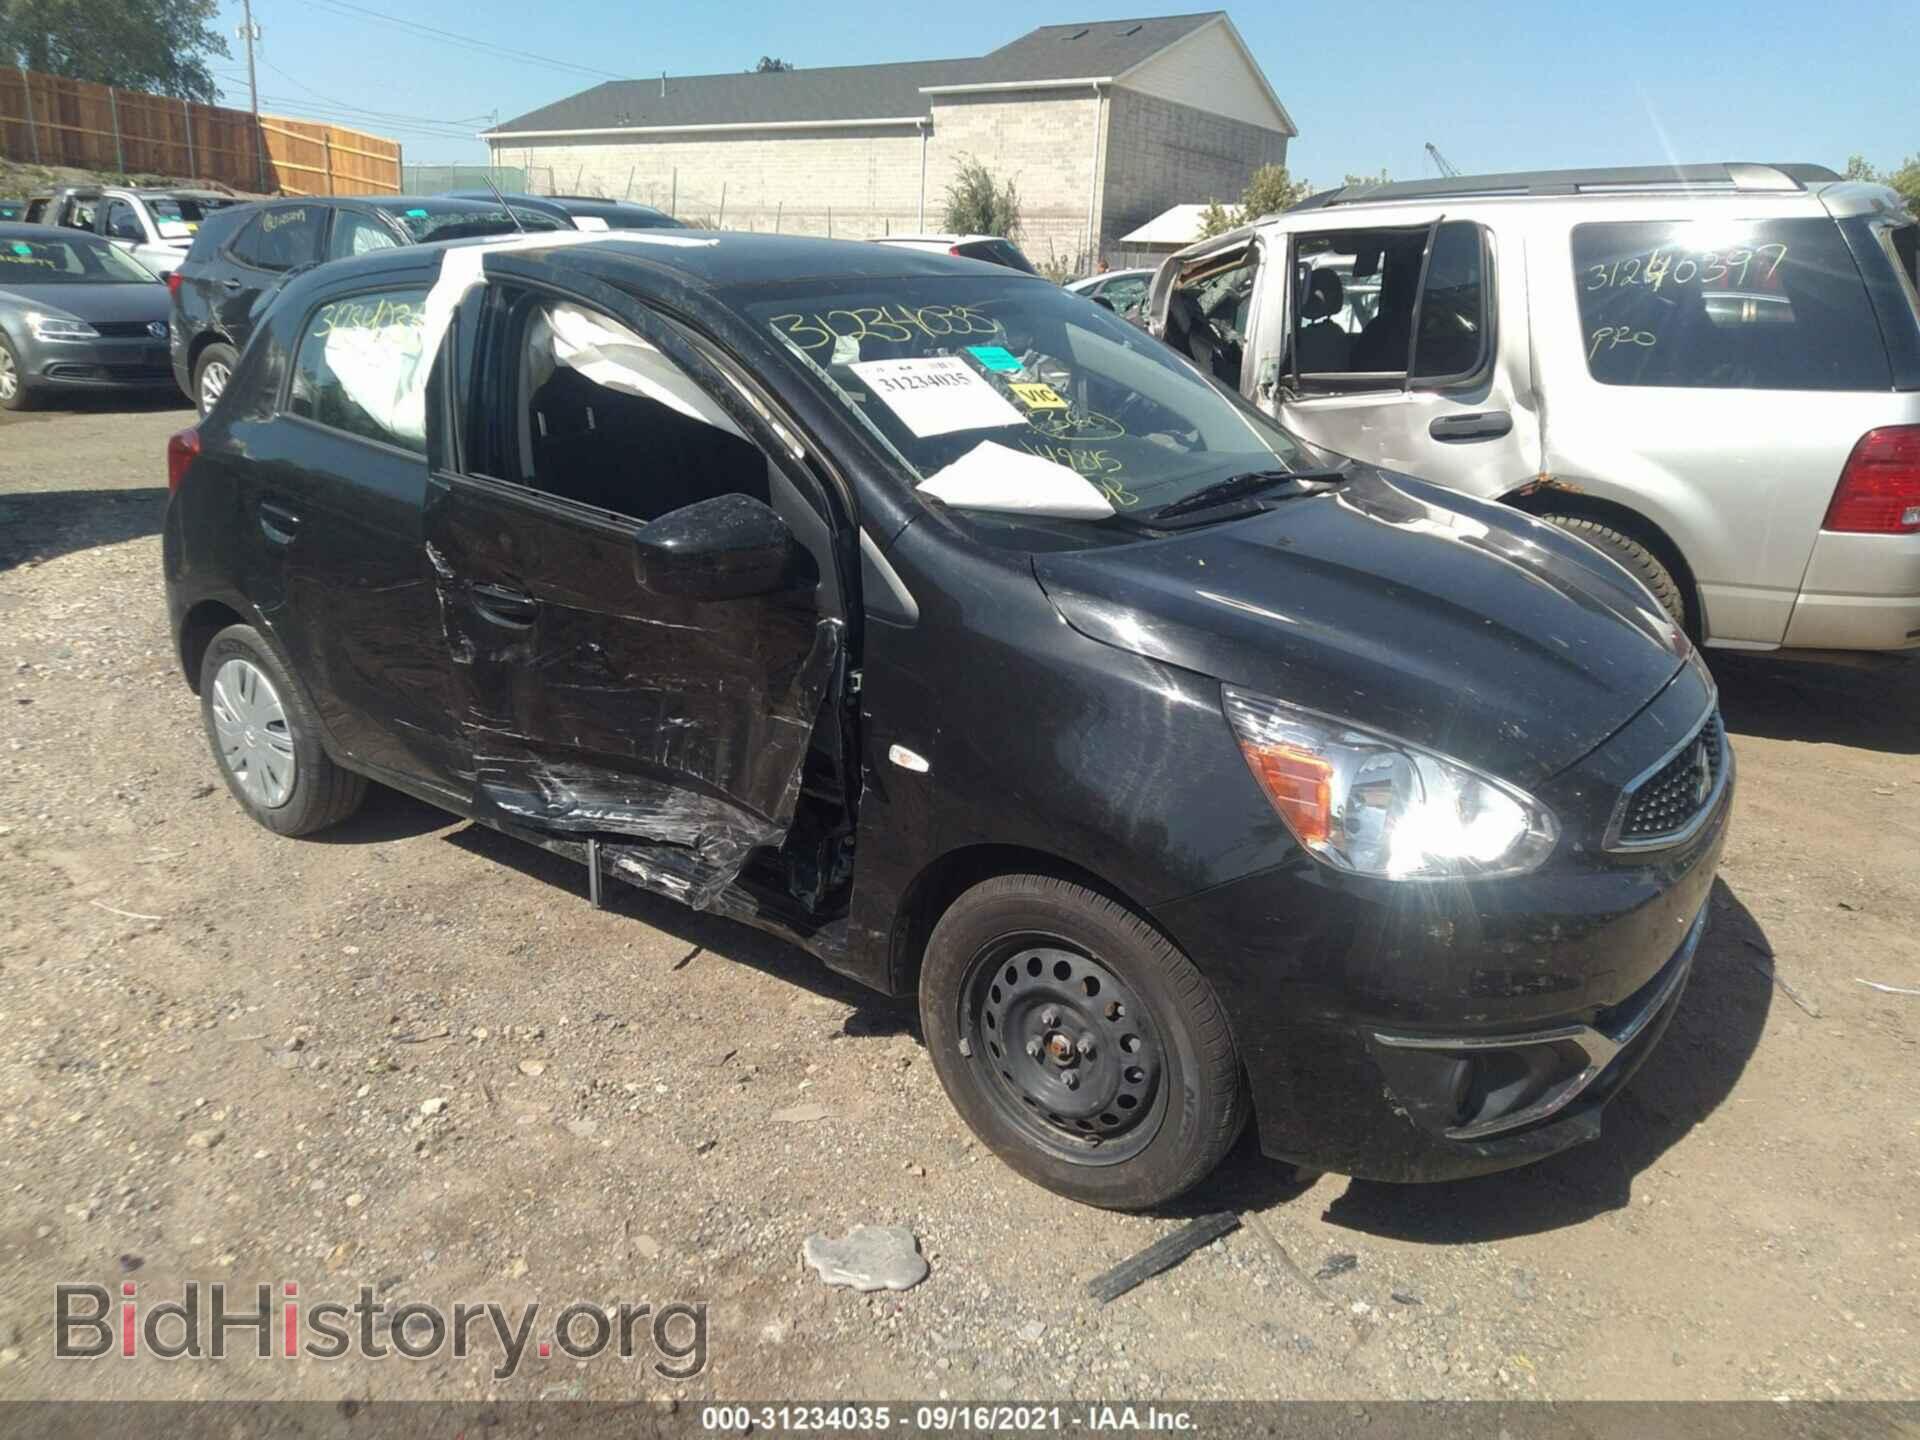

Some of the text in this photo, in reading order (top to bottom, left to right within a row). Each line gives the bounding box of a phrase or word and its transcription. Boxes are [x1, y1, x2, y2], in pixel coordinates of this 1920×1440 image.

[769, 304, 999, 350] 31234035
[878, 372, 971, 393] 31234035
[1018, 389, 1059, 402] VIC
